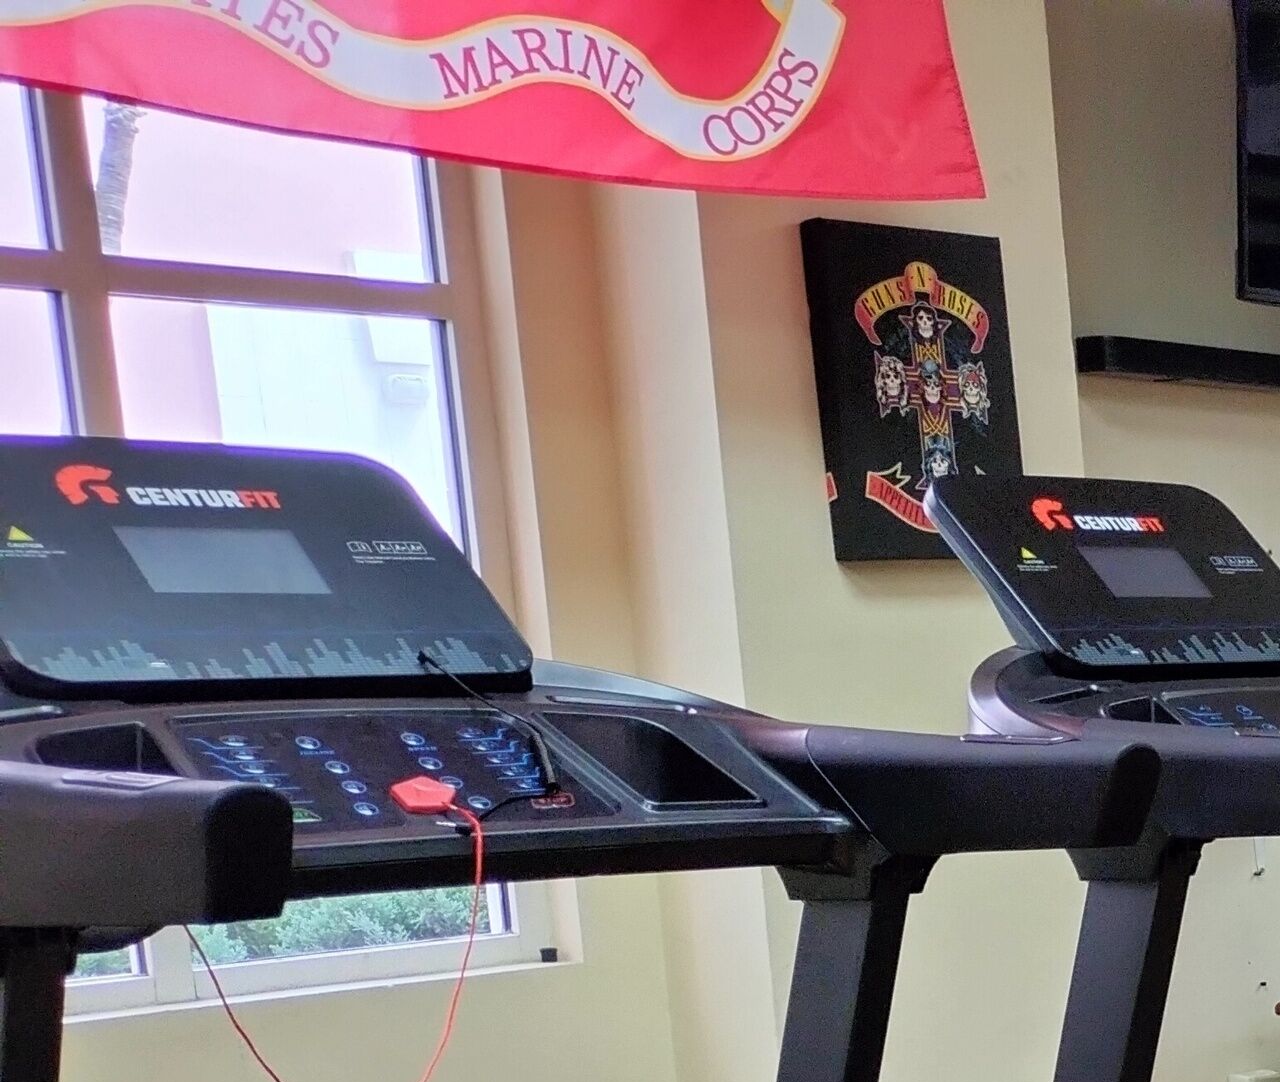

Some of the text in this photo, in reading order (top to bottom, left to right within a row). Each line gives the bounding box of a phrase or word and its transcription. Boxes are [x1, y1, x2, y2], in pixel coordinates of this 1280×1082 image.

[430, 27, 644, 109] MARINE
[703, 51, 820, 157] CORPS
[861, 280, 907, 318] GUNS
[938, 284, 984, 329] ROSES
[126, 486, 281, 509] CENTURFIT
[1074, 515, 1166, 532] CENTURFIT
